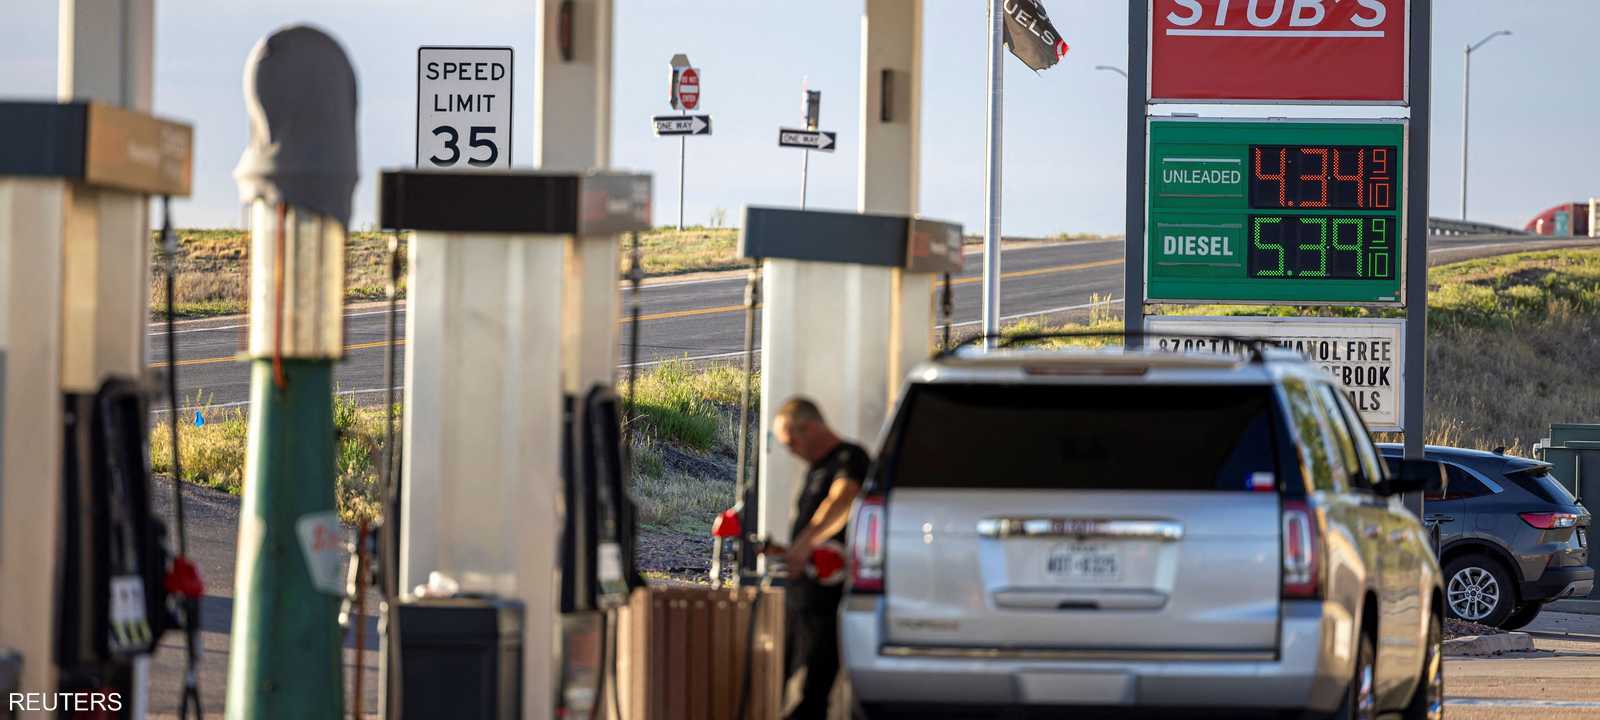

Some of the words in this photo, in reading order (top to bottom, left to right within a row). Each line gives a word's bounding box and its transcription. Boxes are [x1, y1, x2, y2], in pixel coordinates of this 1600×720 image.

[1166, 0, 1387, 28] STUBS
[426, 62, 505, 81] SPEED
[434, 94, 496, 112] LIMIT
[656, 120, 673, 130] ONE
[676, 121, 693, 129] WAY
[429, 125, 499, 168] 35
[783, 134, 799, 142] ONE
[803, 136, 819, 144] WAY
[1163, 169, 1241, 184] UNLEADED
[1255, 148, 1364, 208] 4.34
[1163, 235, 1233, 256] DIESEL
[1254, 217, 1363, 277] 5.39
[1347, 341, 1391, 361] FREE
